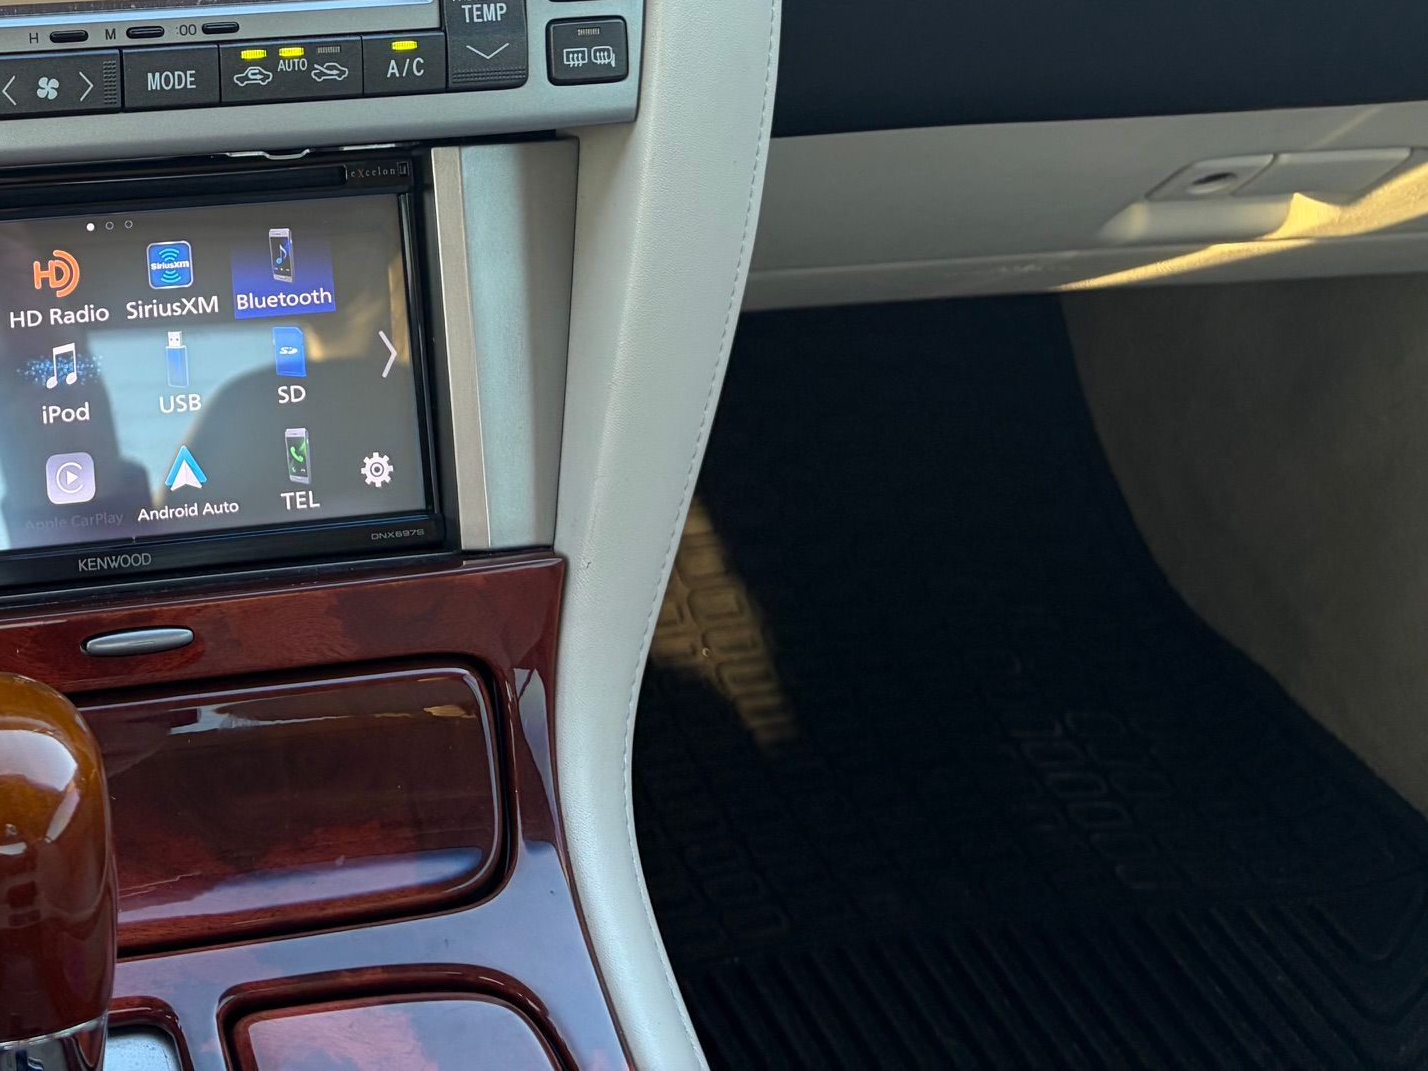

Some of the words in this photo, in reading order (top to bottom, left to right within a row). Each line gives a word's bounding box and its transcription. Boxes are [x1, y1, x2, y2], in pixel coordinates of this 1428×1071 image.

[461, 2, 507, 23] TEMP
[29, 32, 39, 44] H
[105, 28, 117, 41] M
[277, 58, 308, 72] AUTO
[386, 57, 425, 78] A/C
[147, 70, 197, 91] MODE
[126, 295, 220, 320] SiriusXM
[236, 287, 332, 310] Bluetooth
[10, 310, 43, 329] HD
[50, 304, 110, 325] Radio
[159, 393, 202, 414] USB
[277, 385, 306, 404] SD
[42, 401, 90, 424] iPod
[280, 490, 321, 511] TEL
[71, 511, 123, 528] CarPlay
[137, 502, 199, 522] Android
[202, 501, 240, 515] Auto
[78, 552, 152, 572] KENWOOD
